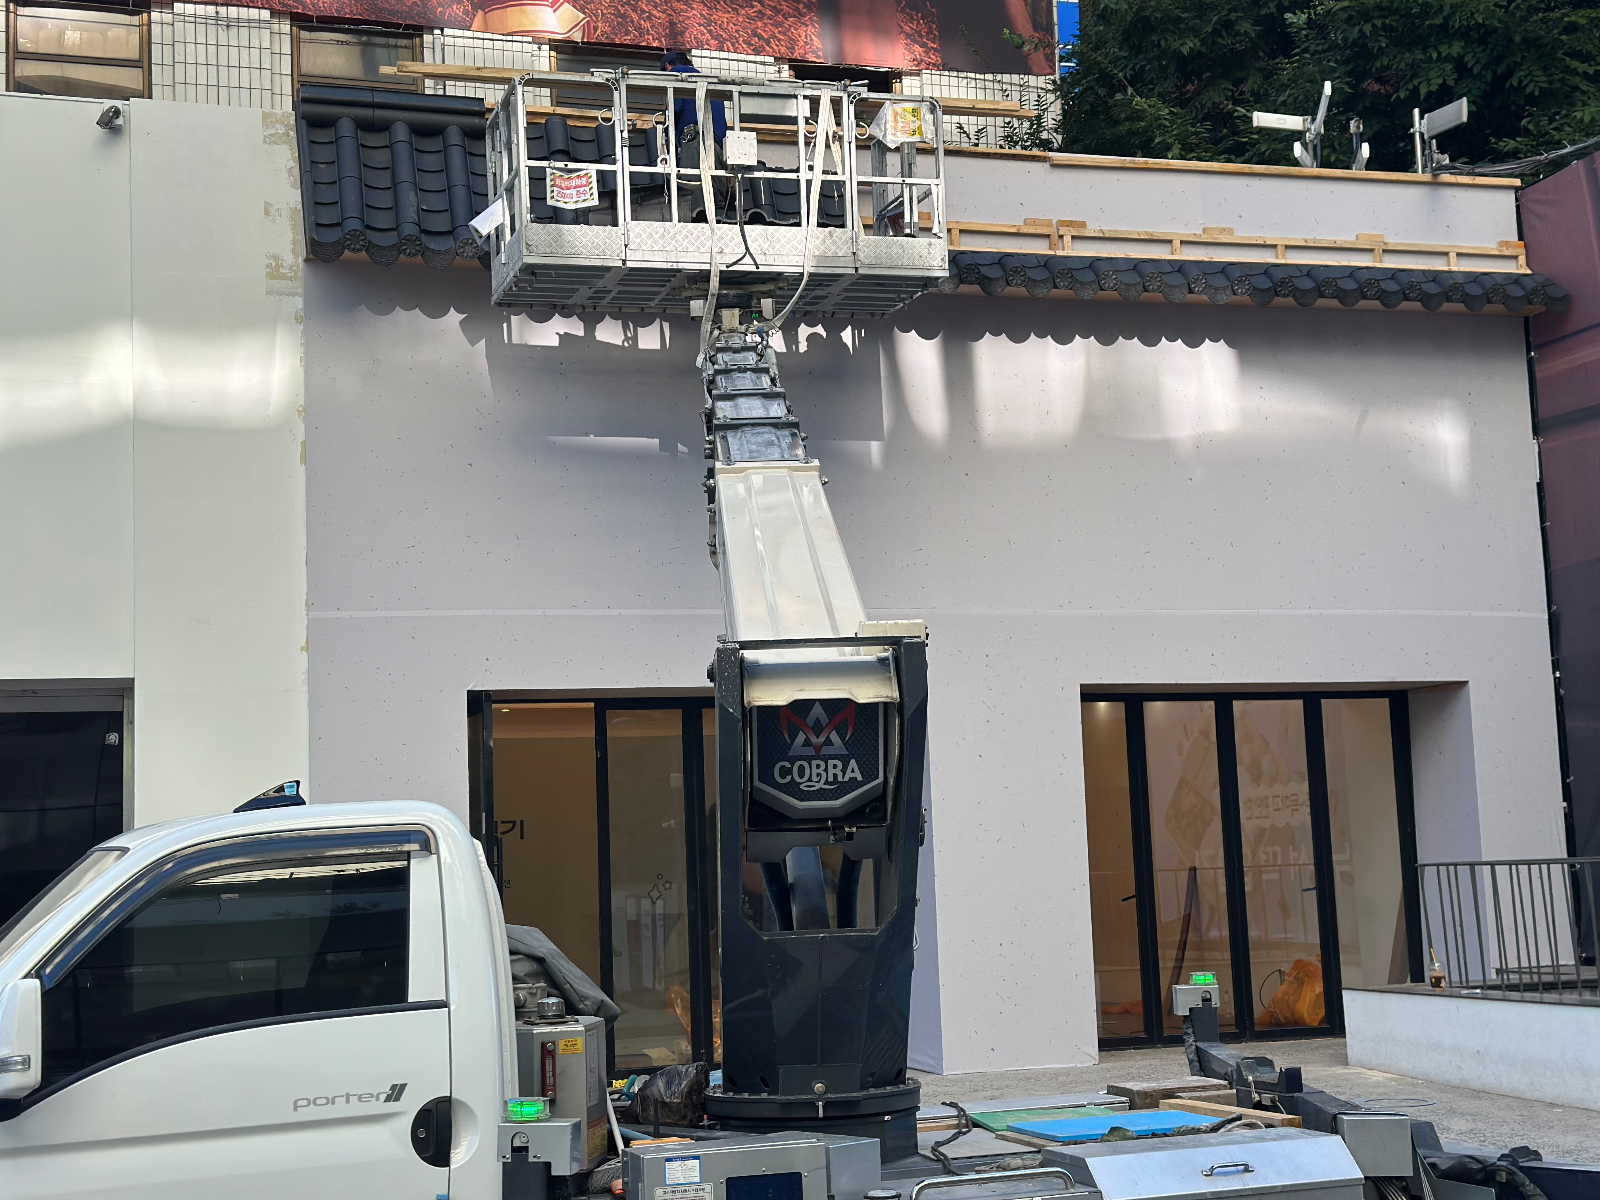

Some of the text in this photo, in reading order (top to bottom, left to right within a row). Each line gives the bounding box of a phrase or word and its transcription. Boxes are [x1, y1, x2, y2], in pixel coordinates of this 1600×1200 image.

[575, 189, 589, 199] 준수
[773, 758, 863, 791] COBRA
[292, 1090, 392, 1112] porter
